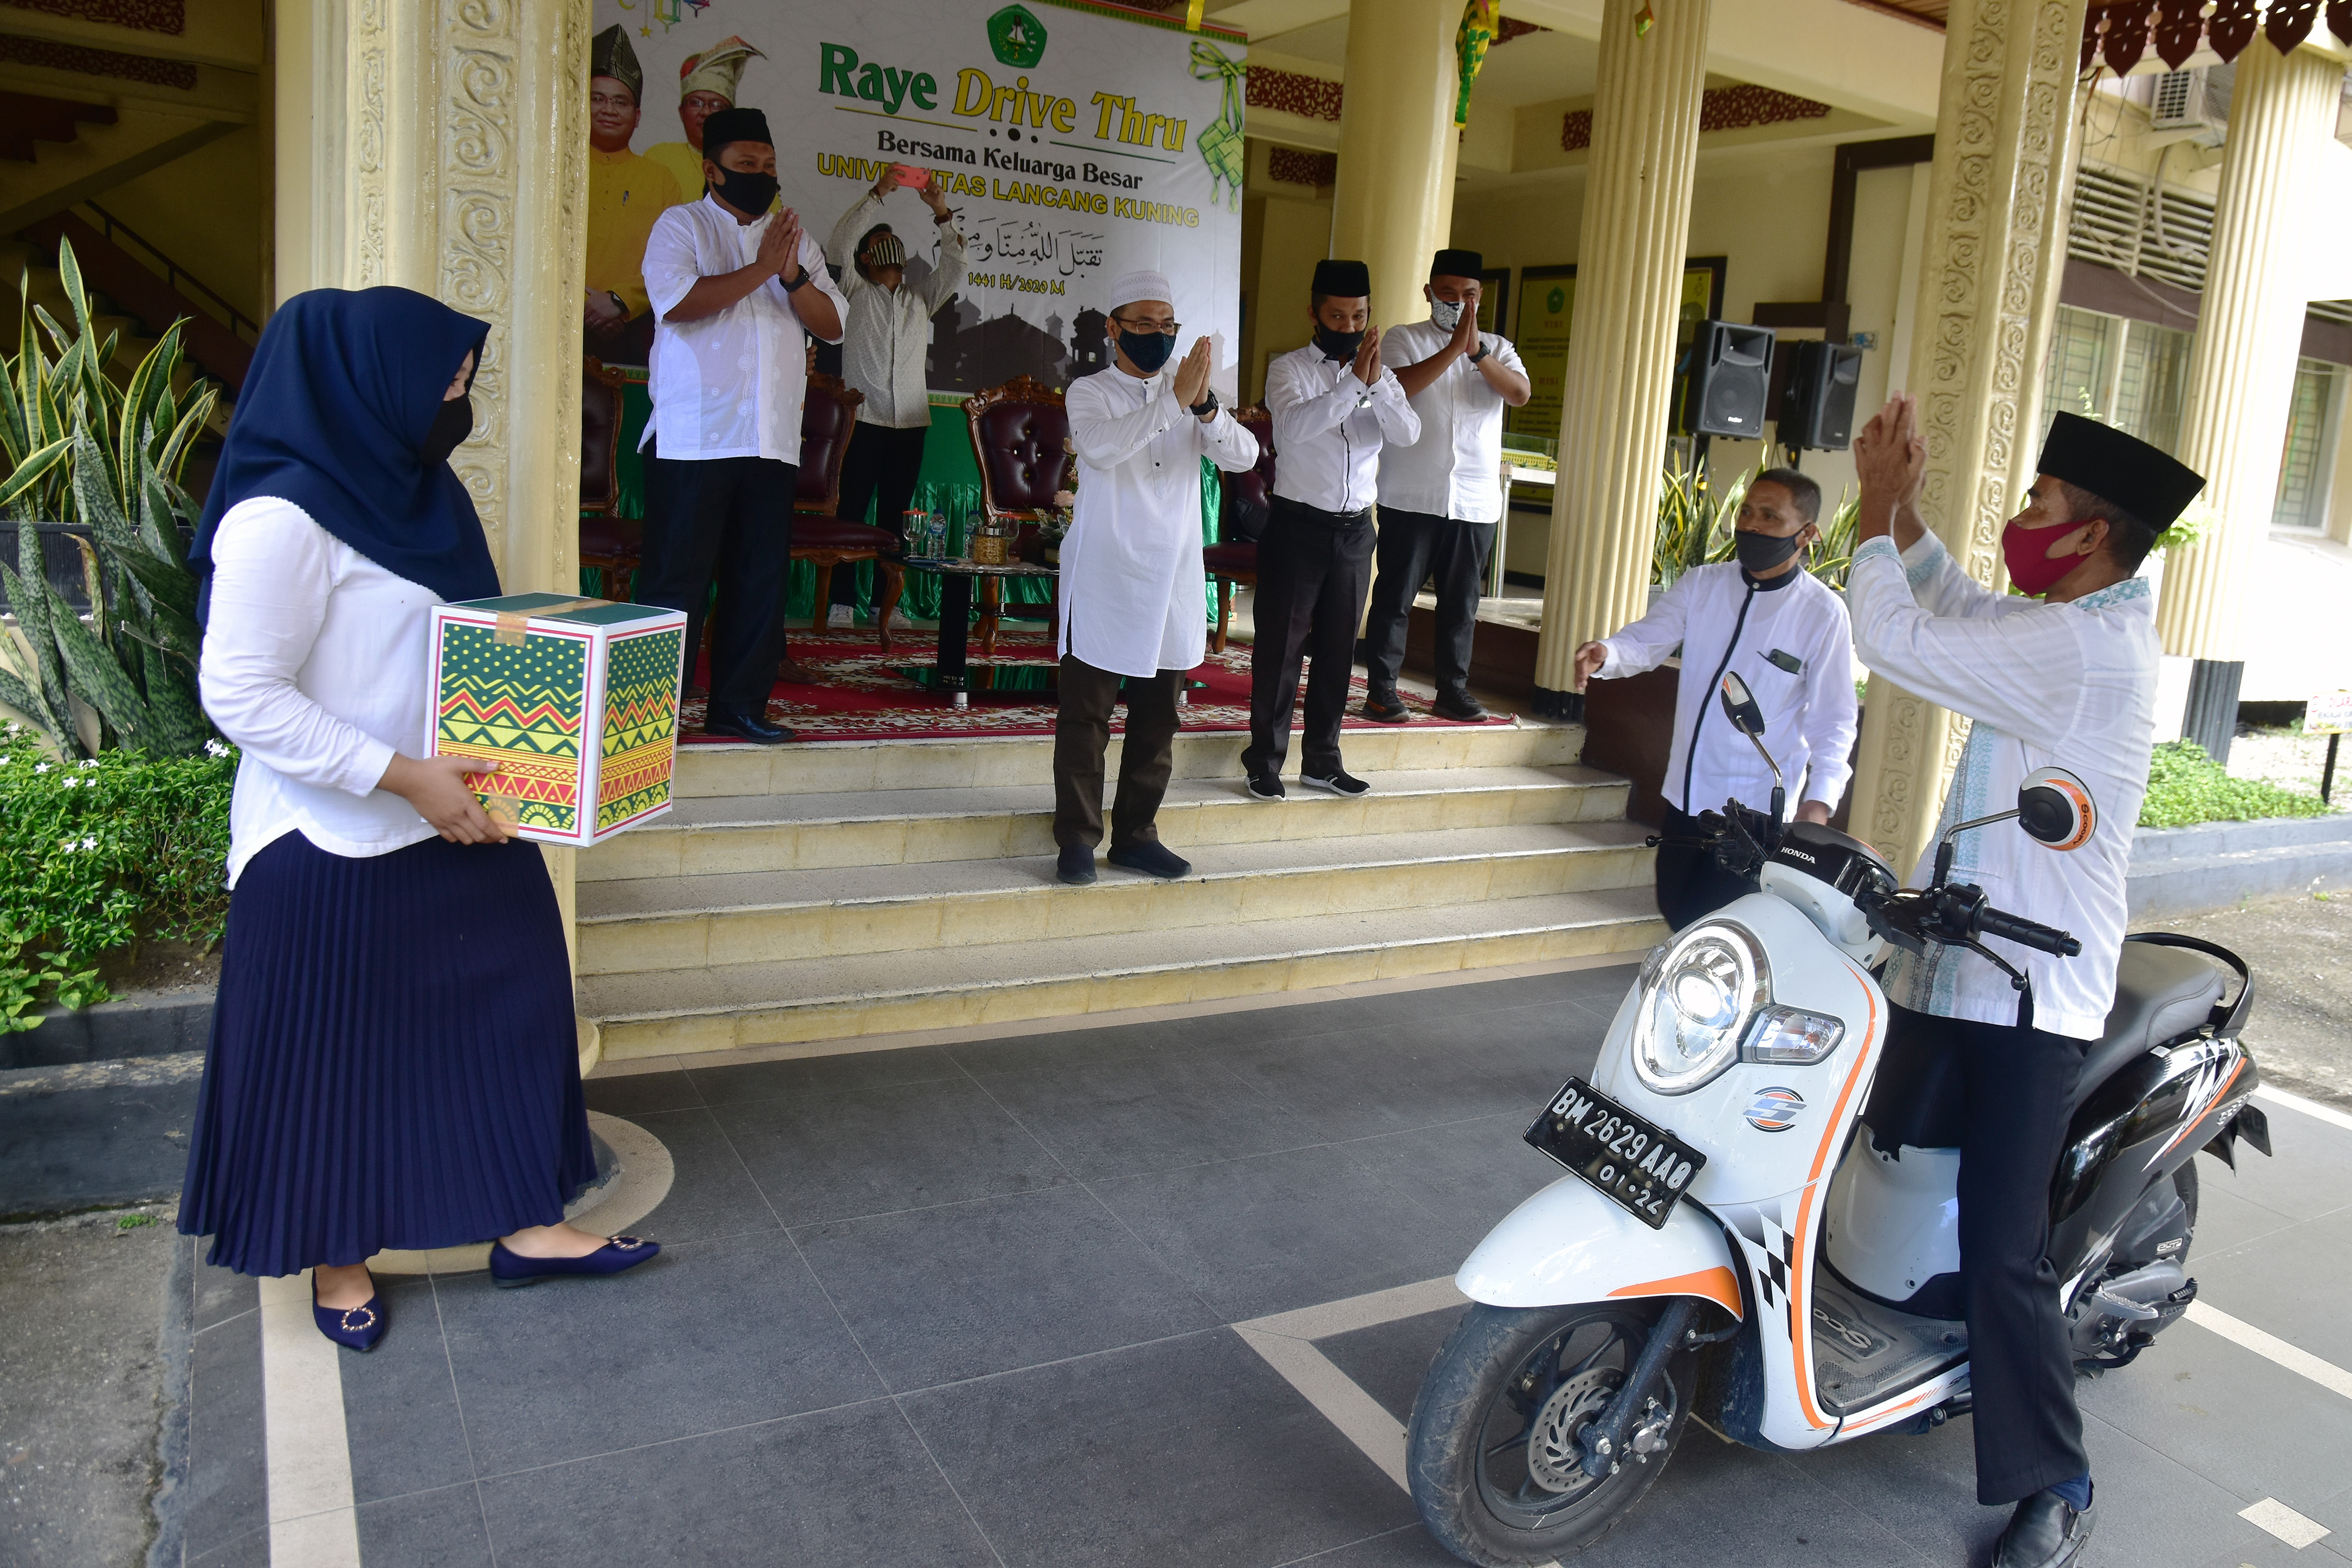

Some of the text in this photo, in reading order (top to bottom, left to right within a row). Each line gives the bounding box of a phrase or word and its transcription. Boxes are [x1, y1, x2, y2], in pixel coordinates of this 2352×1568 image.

[818, 42, 1187, 152] Raye Drive Thru
[877, 130, 1143, 189] Bersama Keluarga Besar
[993, 178, 1108, 214] LANCANG
[1114, 196, 1200, 228] KUNING
[968, 272, 995, 287] 1441
[1050, 279, 1065, 296] M
[1780, 847, 1816, 864] HONDA
[1552, 1088, 1594, 1125] BM
[1583, 1109, 1648, 1160] 2629
